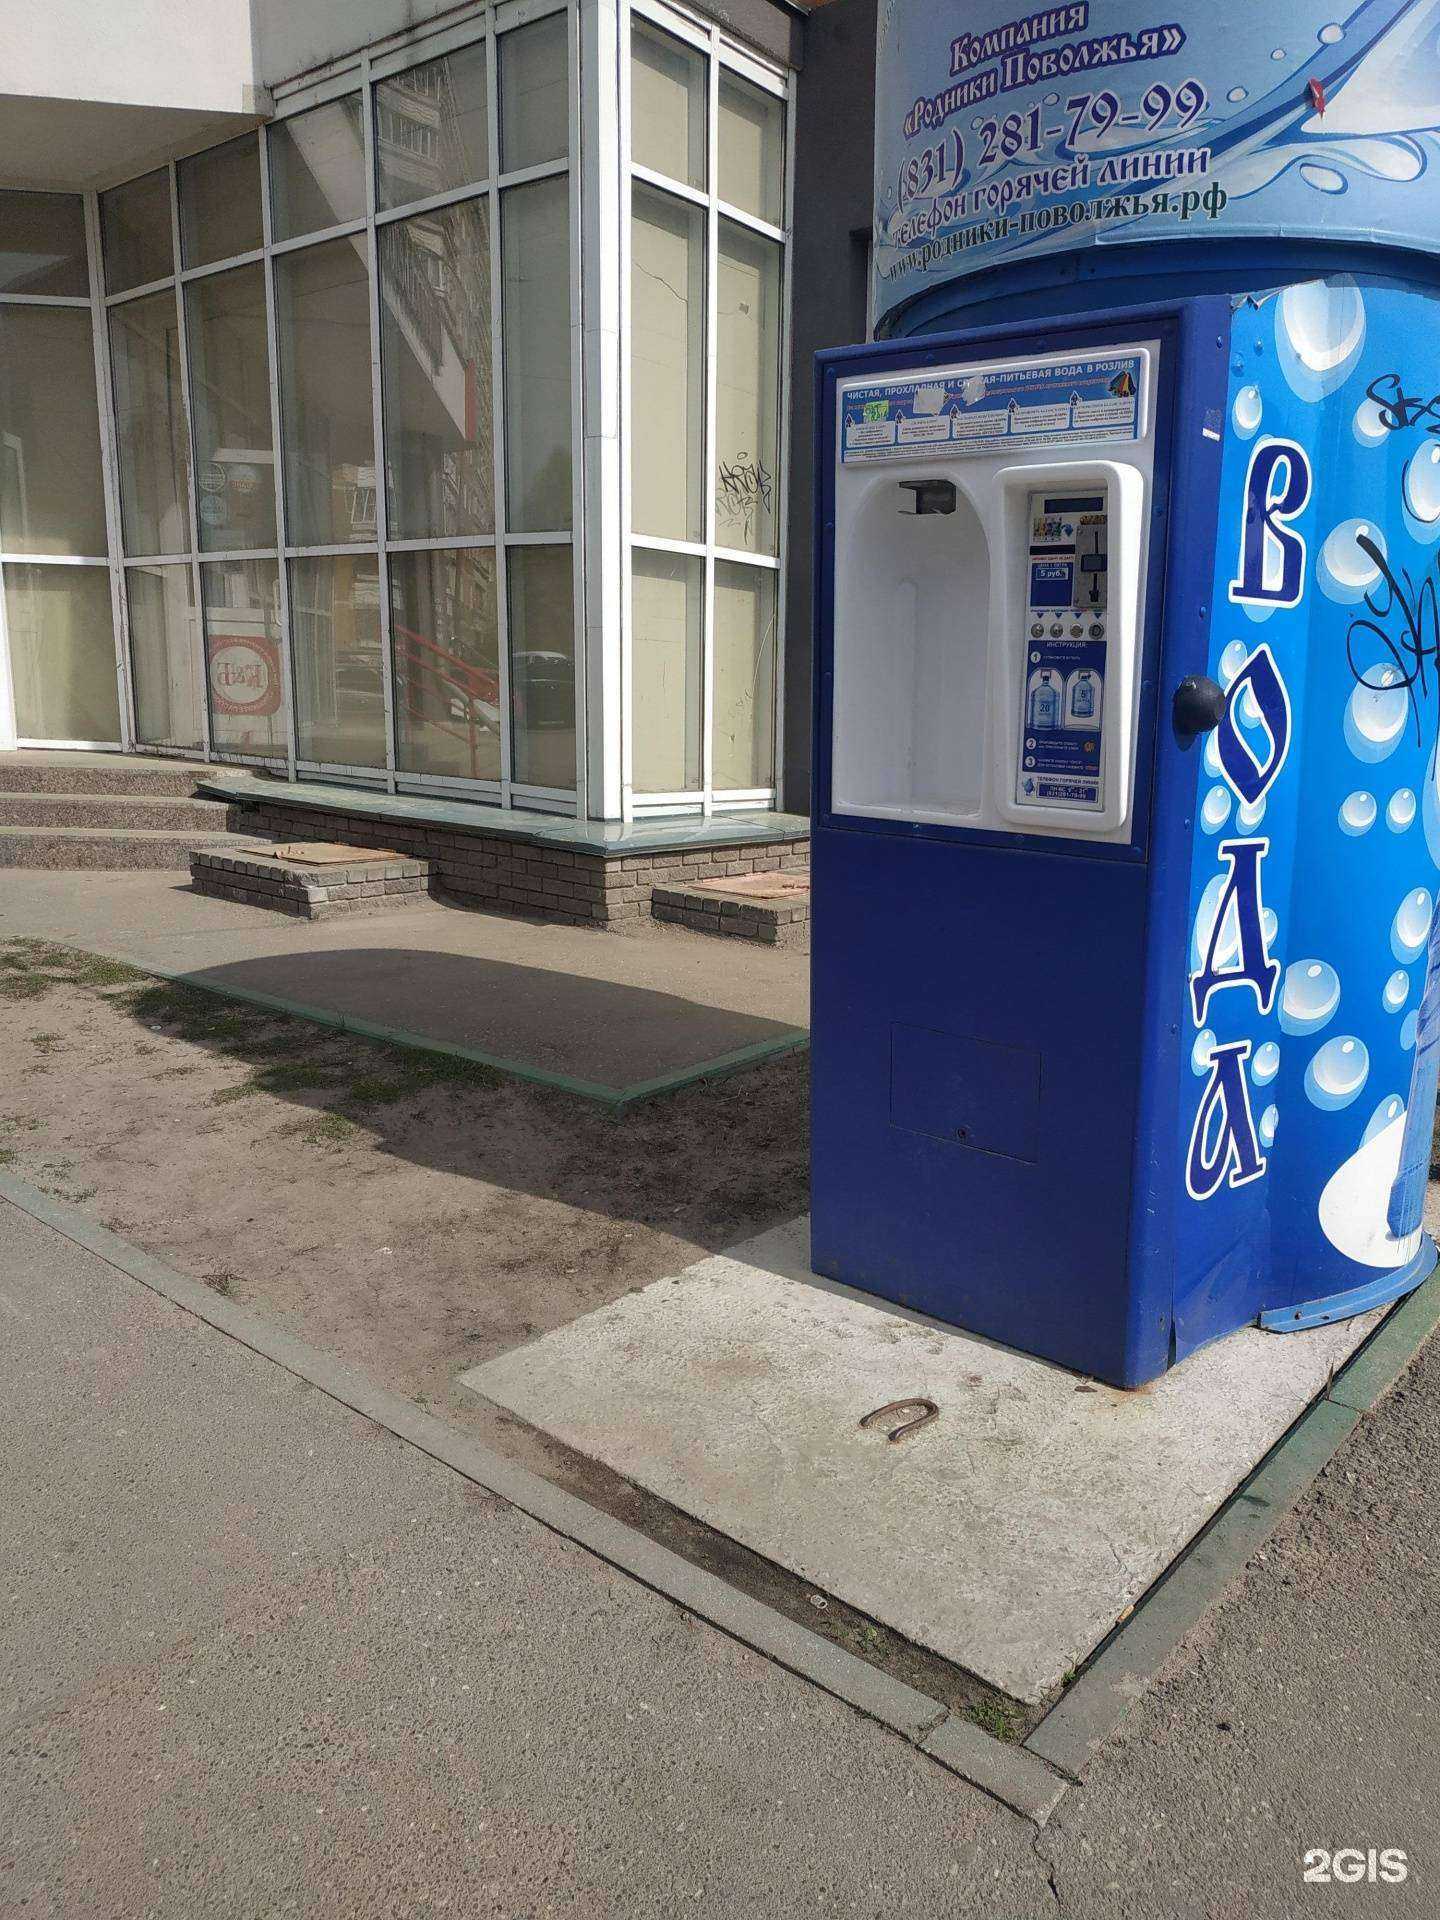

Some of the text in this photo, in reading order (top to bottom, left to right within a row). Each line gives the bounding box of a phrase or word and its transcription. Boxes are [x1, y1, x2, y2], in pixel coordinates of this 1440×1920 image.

[951, 3, 1088, 75] Компания
[903, 26, 1185, 138] «Родники Поволжья»
[898, 80, 1206, 213] (831) 281-79-99
[974, 157, 1089, 213] горячей
[1100, 150, 1209, 183] линии
[847, 389, 882, 399] ЧИСТАЯ,
[1055, 366, 1083, 377] ВОДА
[1087, 365, 1093, 373] В
[1095, 360, 1135, 372] РОЗЛИВ
[1040, 703, 1051, 714] 20
[1186, 438, 1313, 1202] ВОДА
